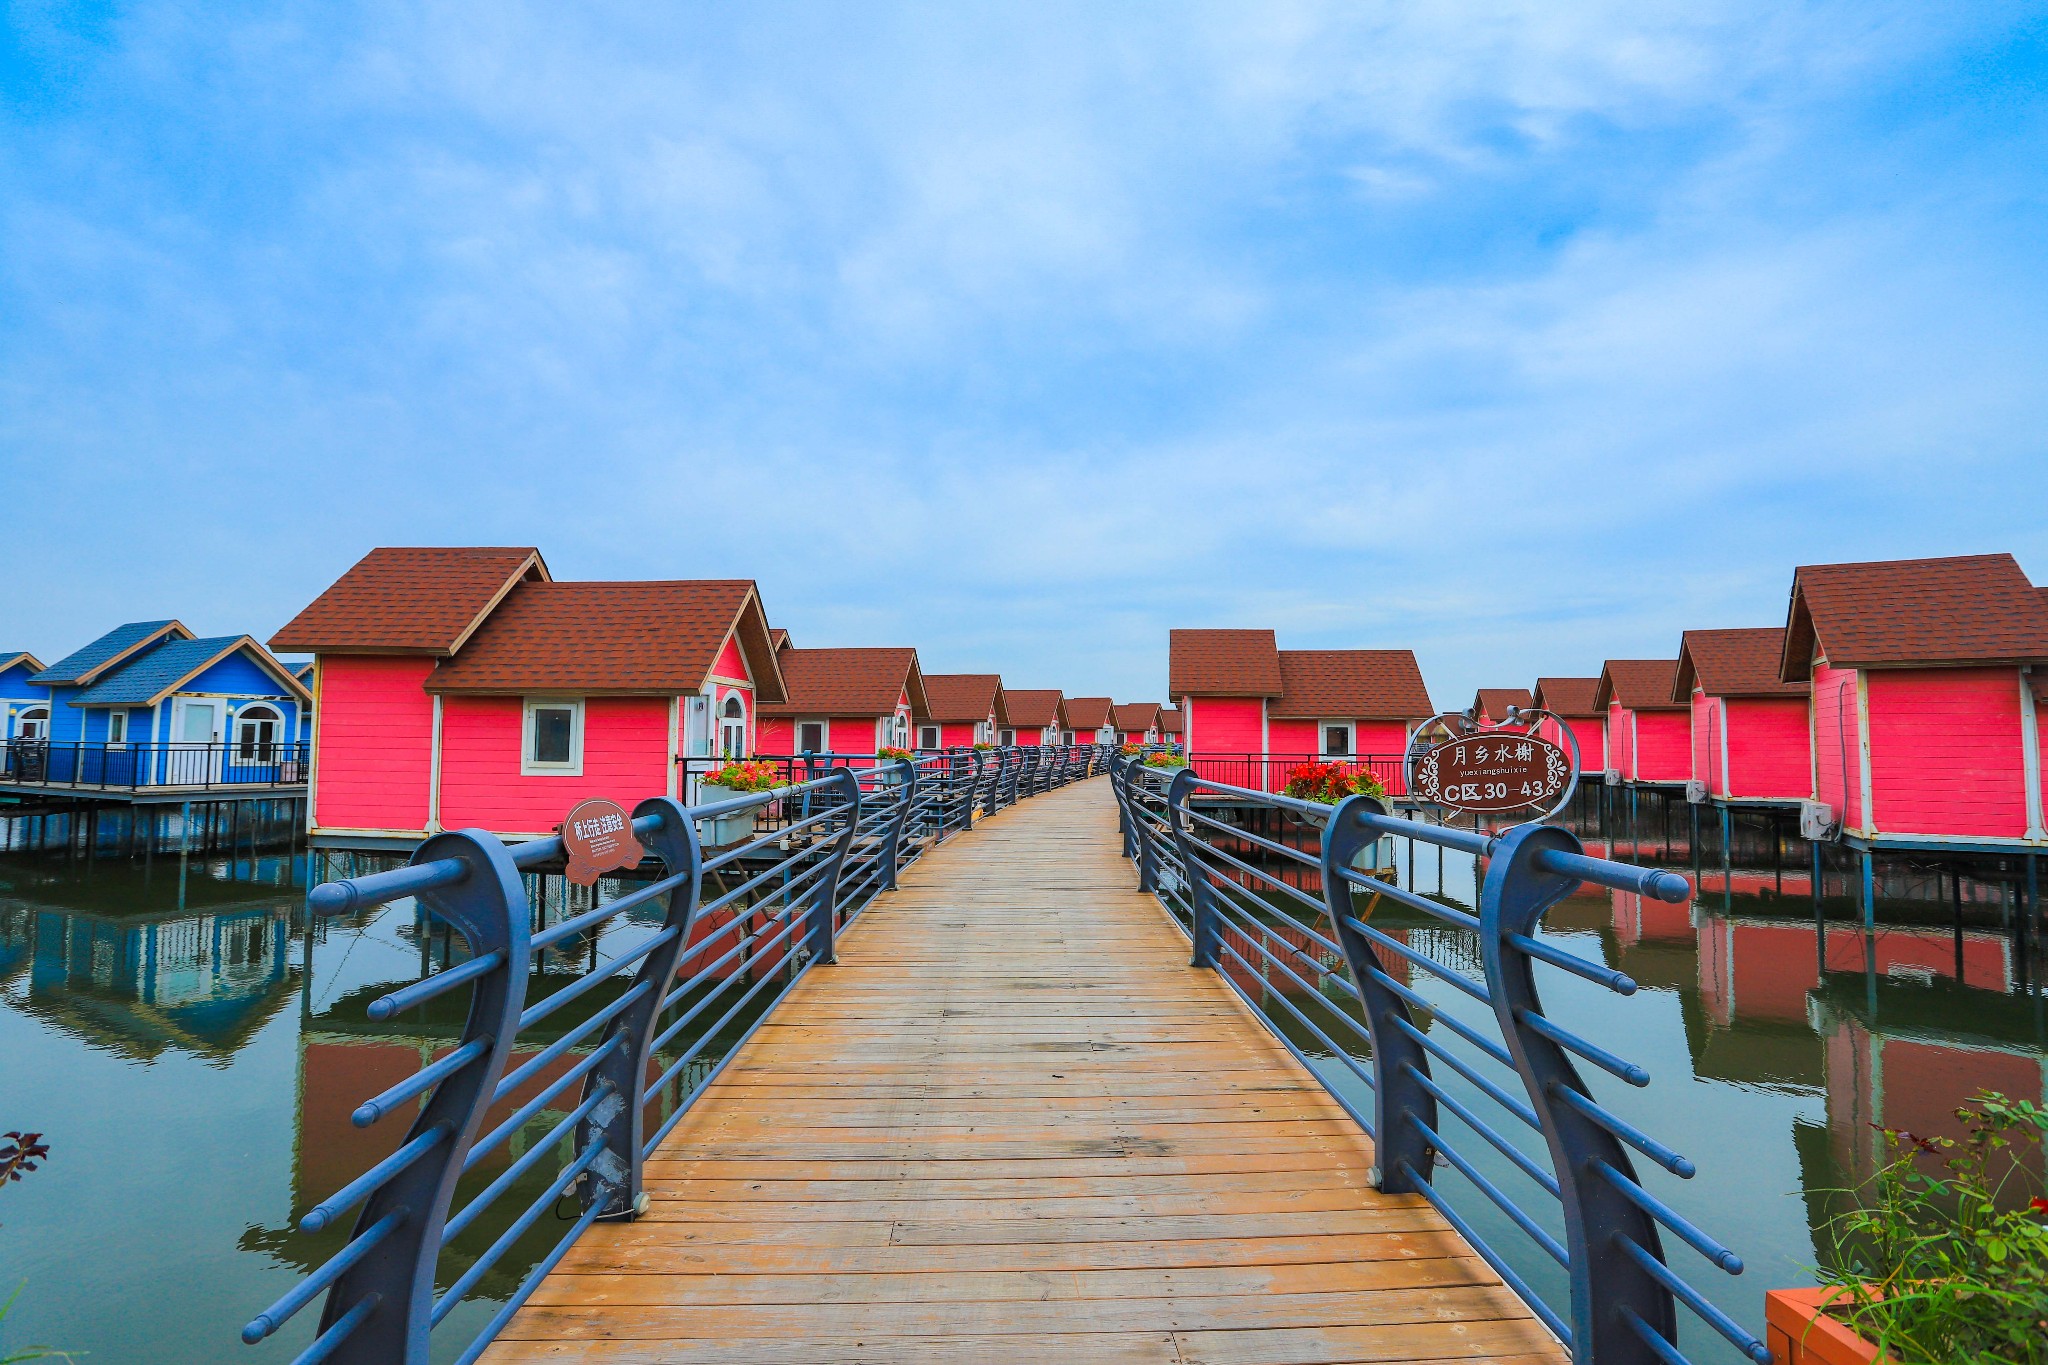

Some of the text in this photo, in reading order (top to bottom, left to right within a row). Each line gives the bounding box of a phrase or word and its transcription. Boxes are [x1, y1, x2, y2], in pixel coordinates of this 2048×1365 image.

[1452, 742, 1534, 767] 月乡水榭
[1460, 766, 1527, 777] yuexiangshuixie
